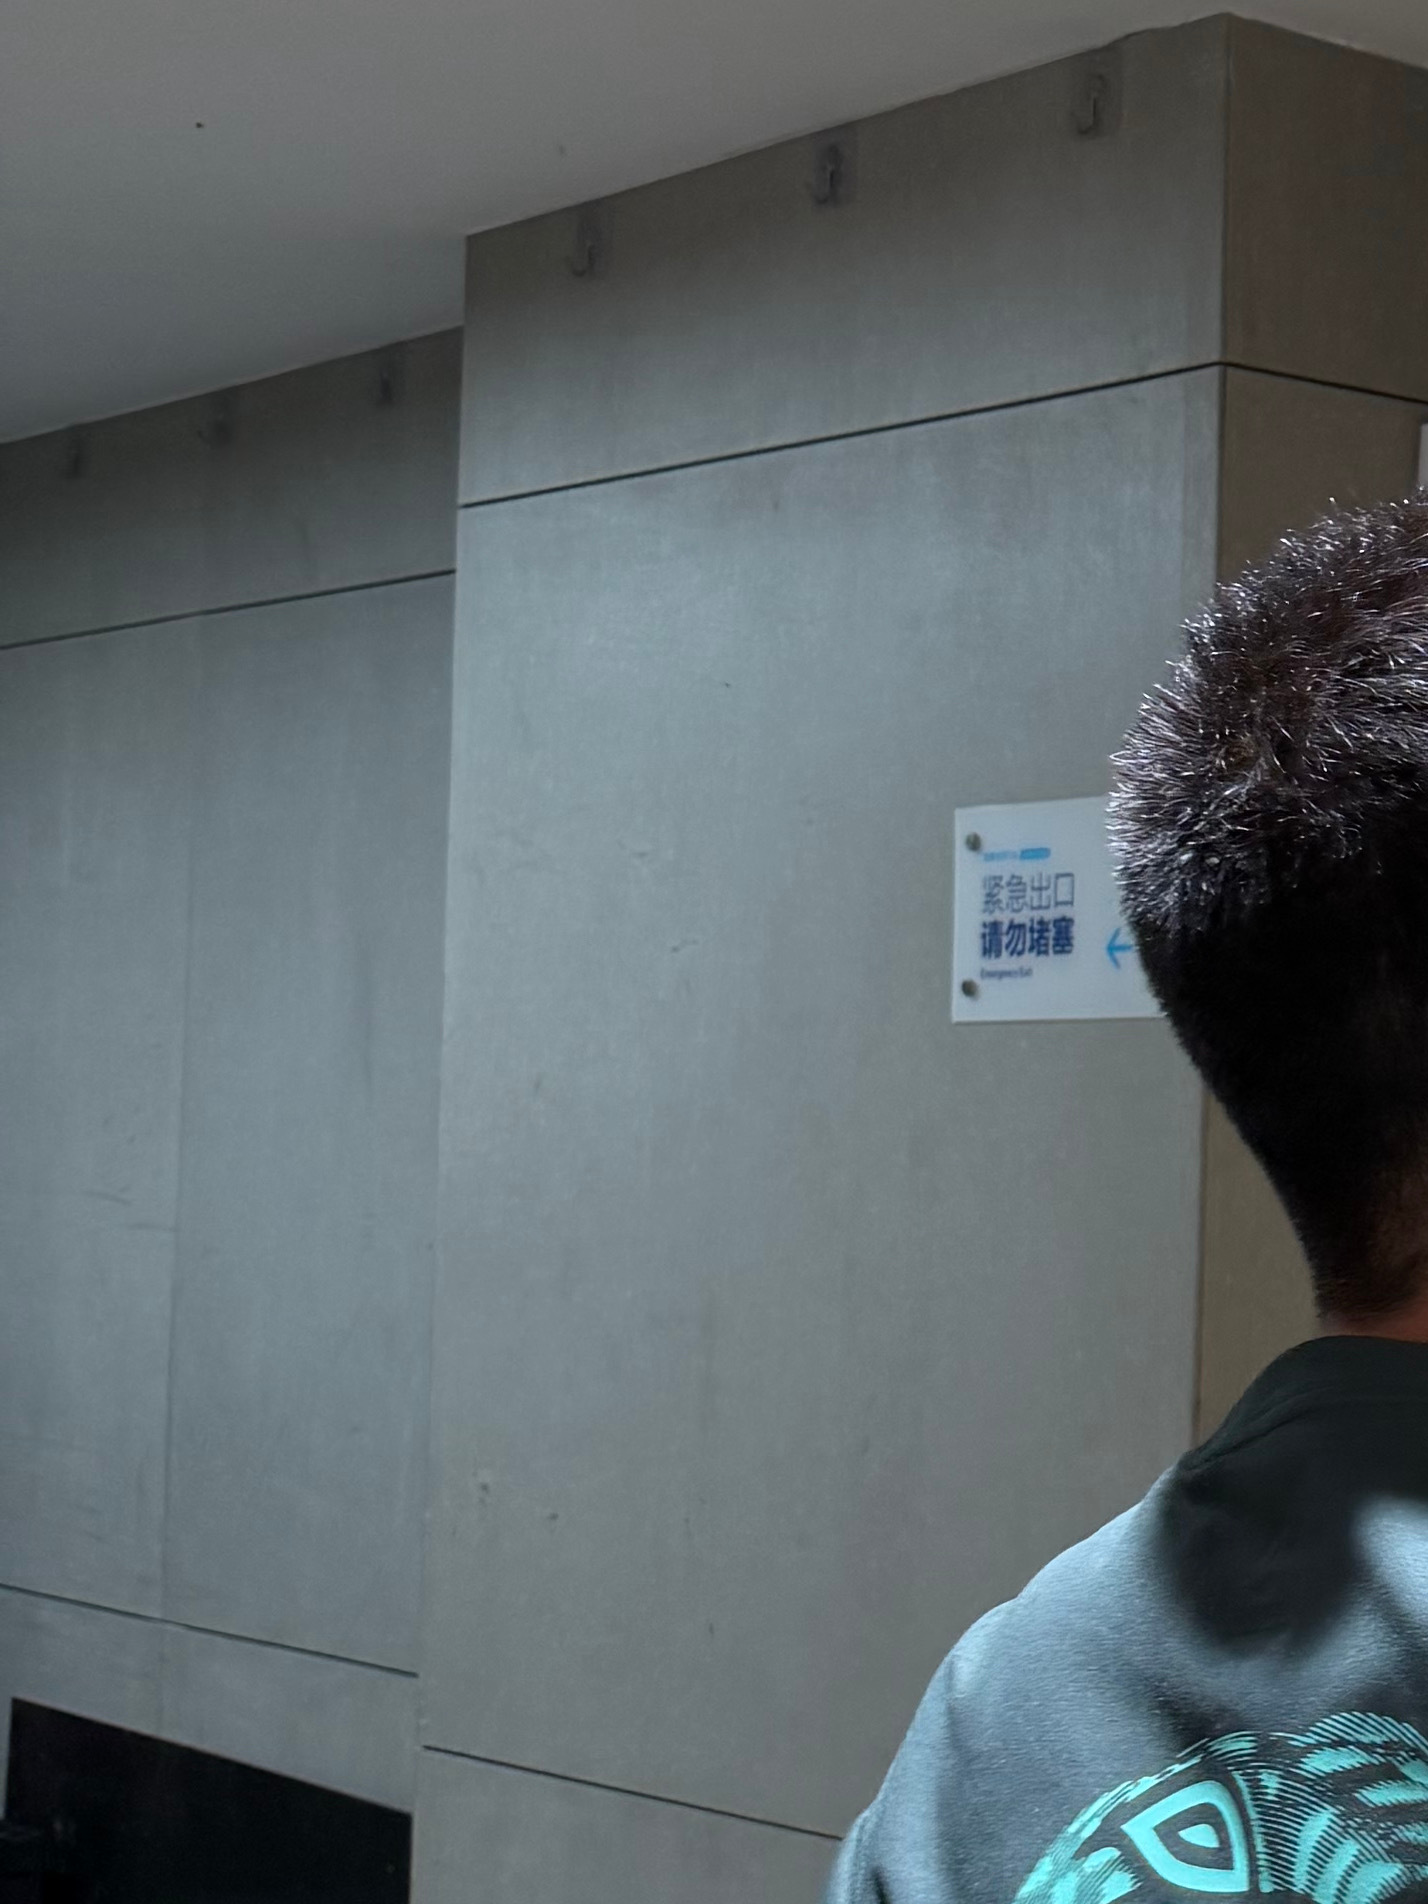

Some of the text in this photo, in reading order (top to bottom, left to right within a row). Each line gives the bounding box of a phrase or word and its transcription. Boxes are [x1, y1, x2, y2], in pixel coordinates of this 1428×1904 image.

[981, 871, 1075, 915] 紧急出口
[980, 916, 1075, 960] 请勿堵塞
